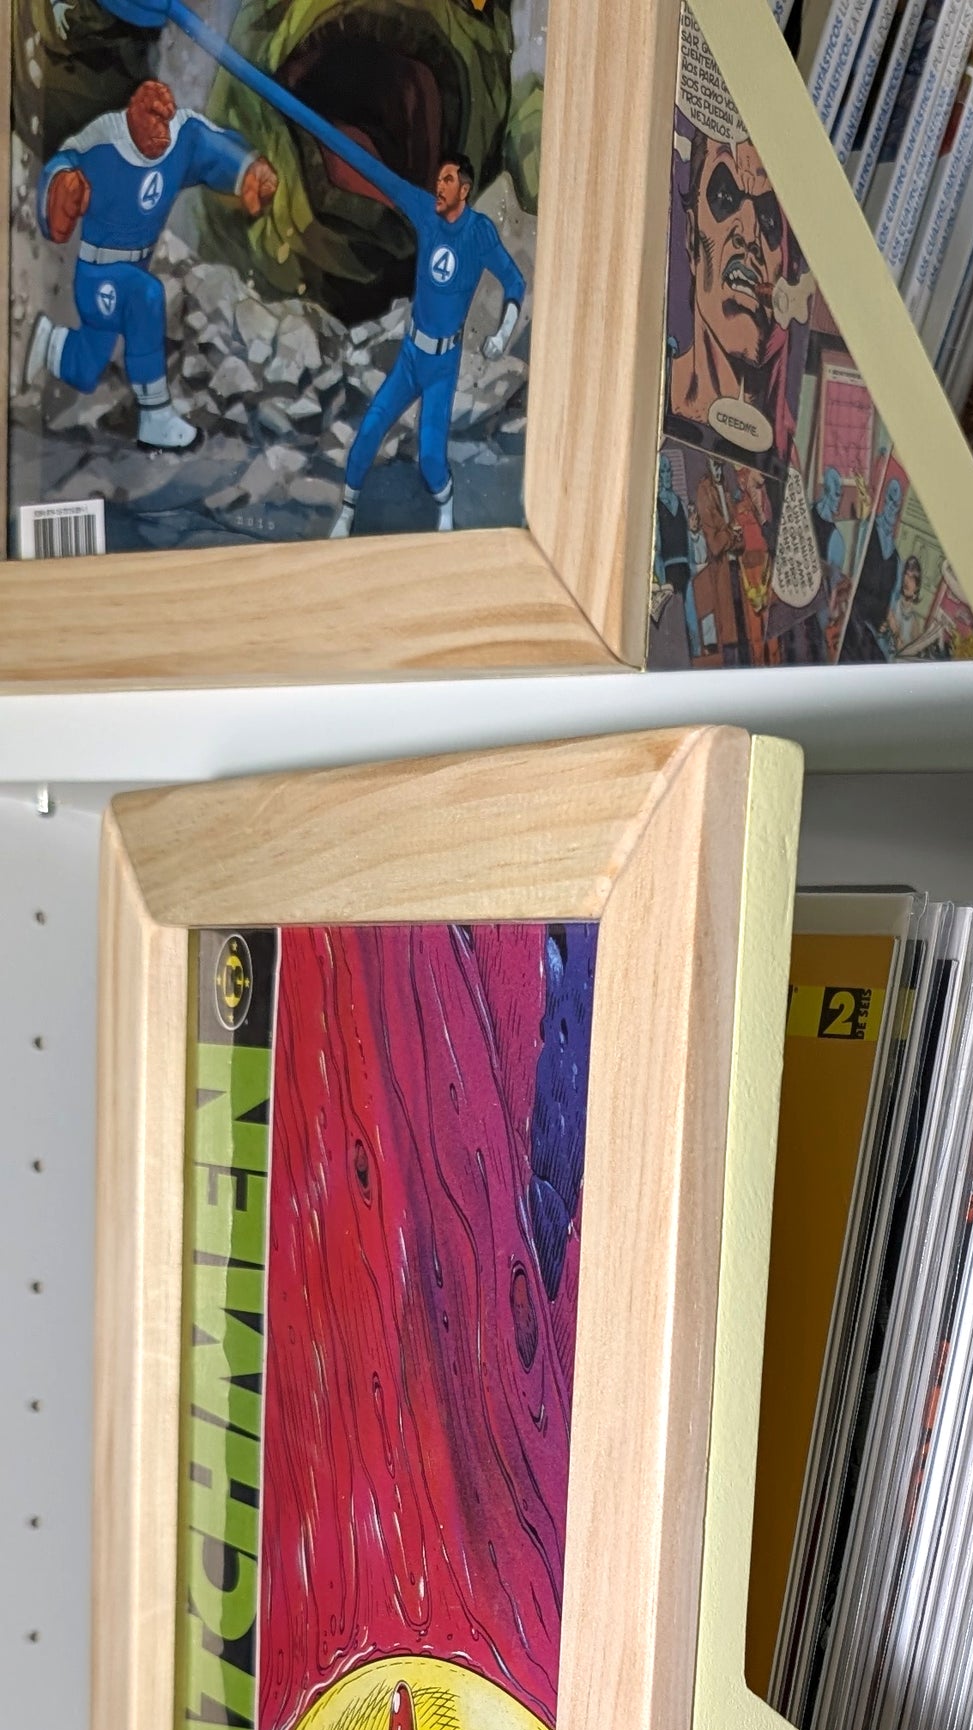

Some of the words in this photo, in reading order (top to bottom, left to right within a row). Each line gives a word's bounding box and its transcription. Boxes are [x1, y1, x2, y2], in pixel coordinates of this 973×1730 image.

[716, 412, 759, 438] CREEDME.
[823, 991, 855, 1035] 2
[860, 988, 873, 1019] SEIS
